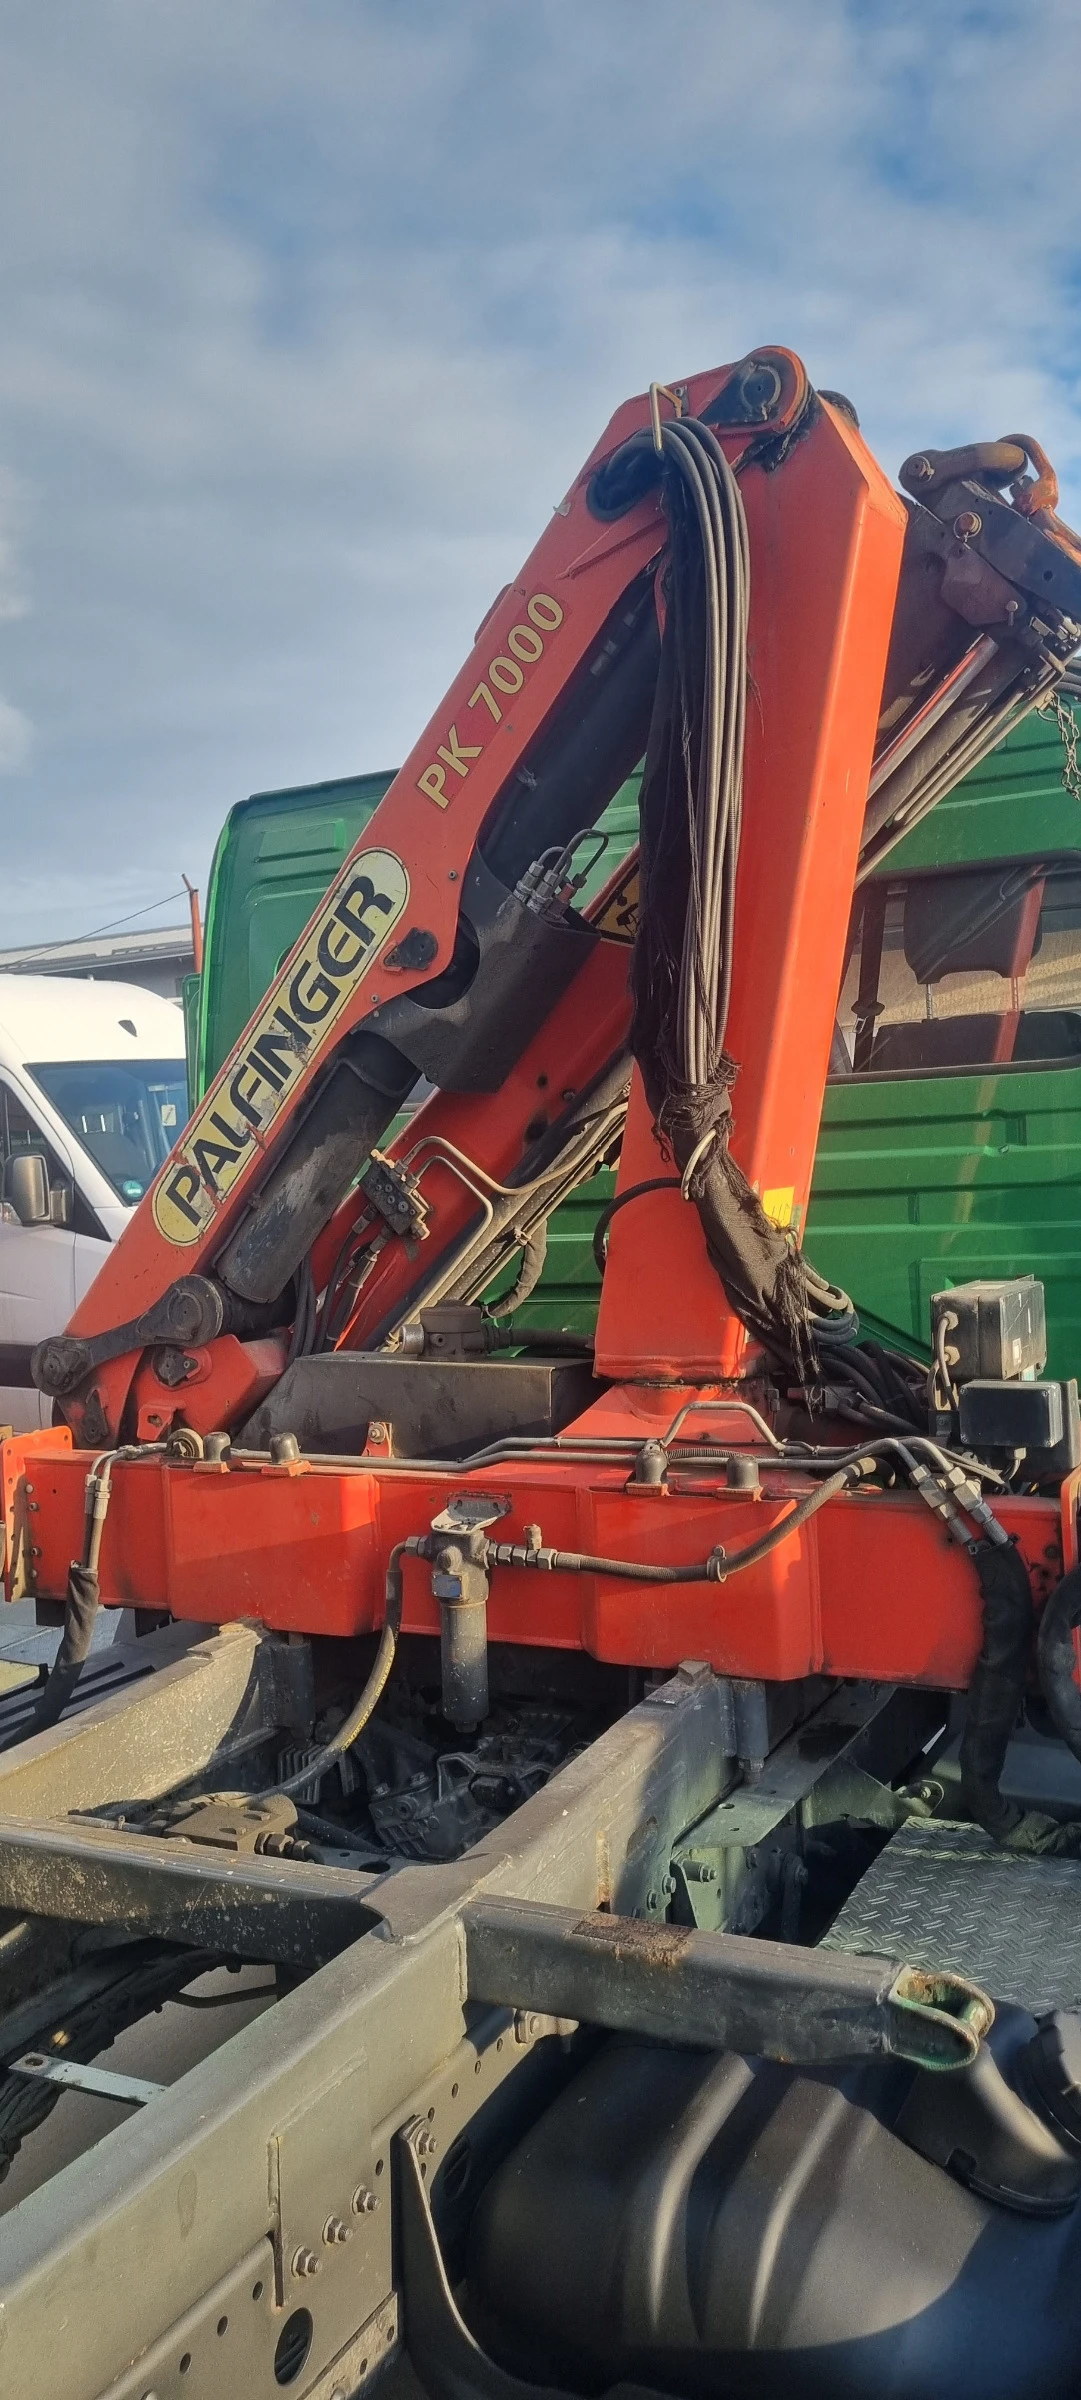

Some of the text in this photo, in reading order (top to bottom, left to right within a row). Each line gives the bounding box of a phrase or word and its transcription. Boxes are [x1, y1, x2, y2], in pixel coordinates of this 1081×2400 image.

[416, 592, 564, 810] PK 7000
[165, 875, 396, 1227] PALFINGER
